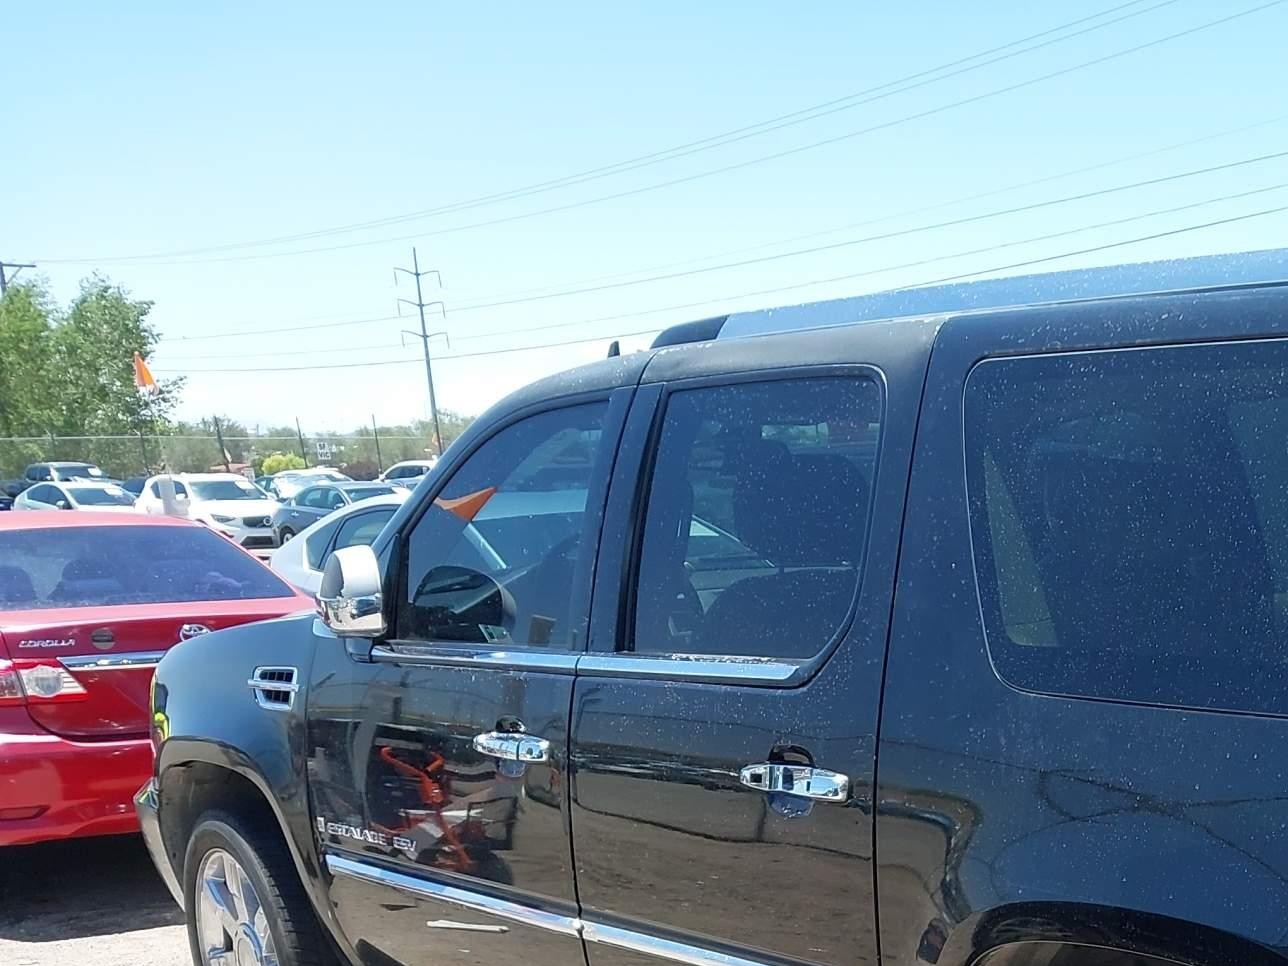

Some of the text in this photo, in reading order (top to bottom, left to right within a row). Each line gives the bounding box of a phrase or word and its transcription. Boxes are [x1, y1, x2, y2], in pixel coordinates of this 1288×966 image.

[18, 639, 76, 648] COROLLA
[326, 822, 417, 851] ESCALADE ESV
